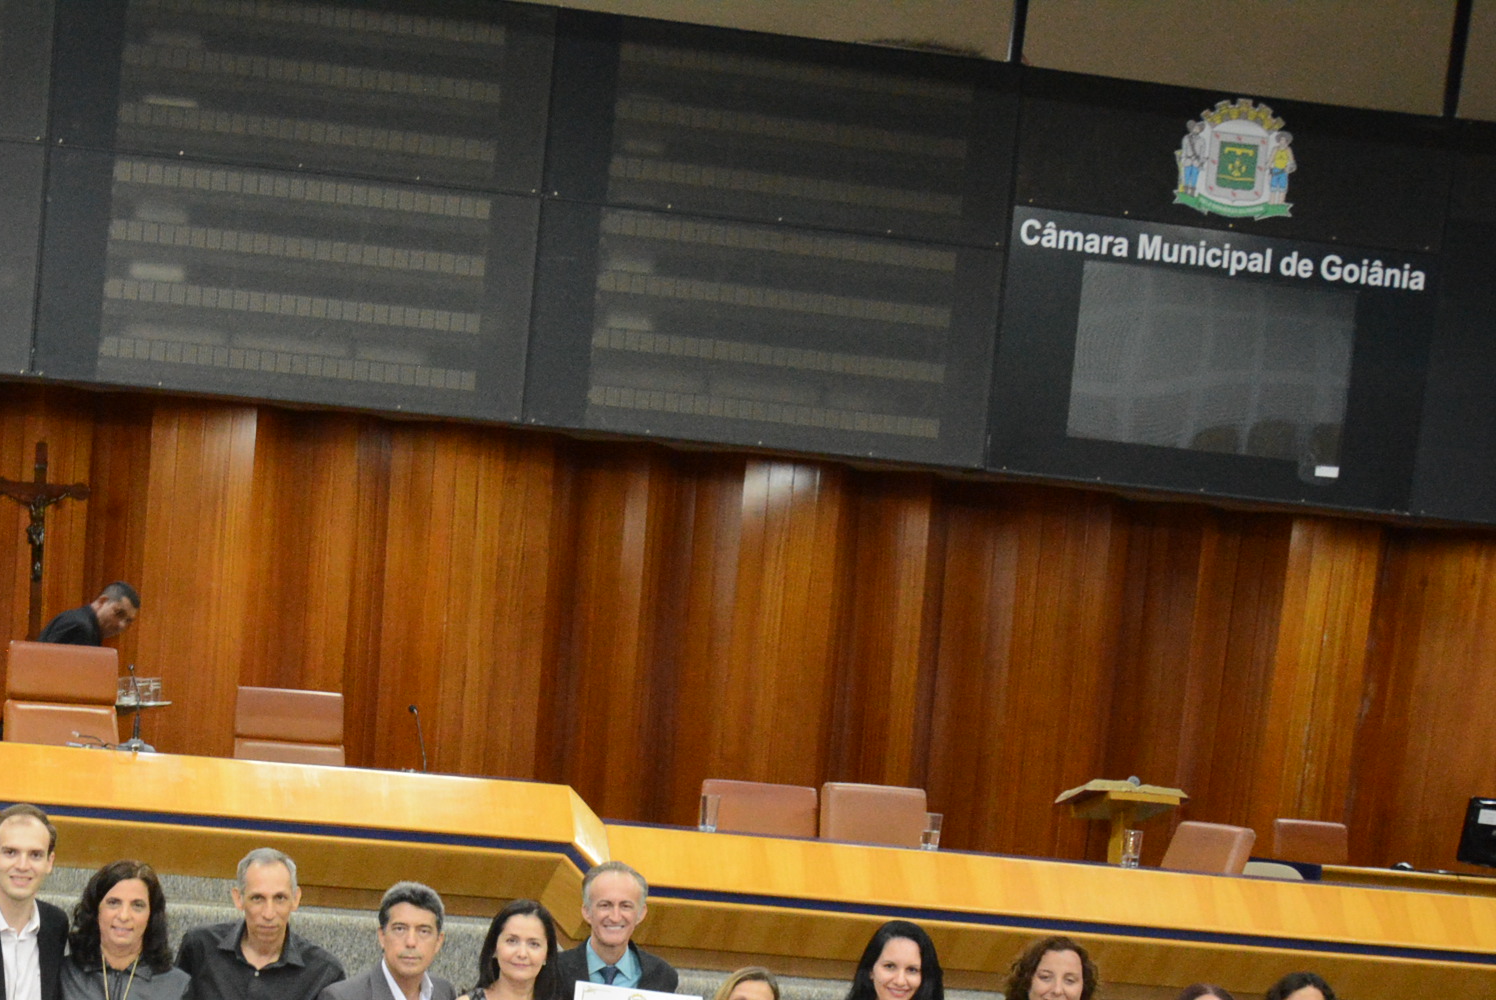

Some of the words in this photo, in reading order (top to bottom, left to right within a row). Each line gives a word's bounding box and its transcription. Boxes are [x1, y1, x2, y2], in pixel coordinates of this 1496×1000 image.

[1020, 218, 1129, 258] Câmara
[1137, 233, 1273, 276] Municipal
[1280, 251, 1314, 278] de
[1320, 254, 1425, 290] Goiânia
